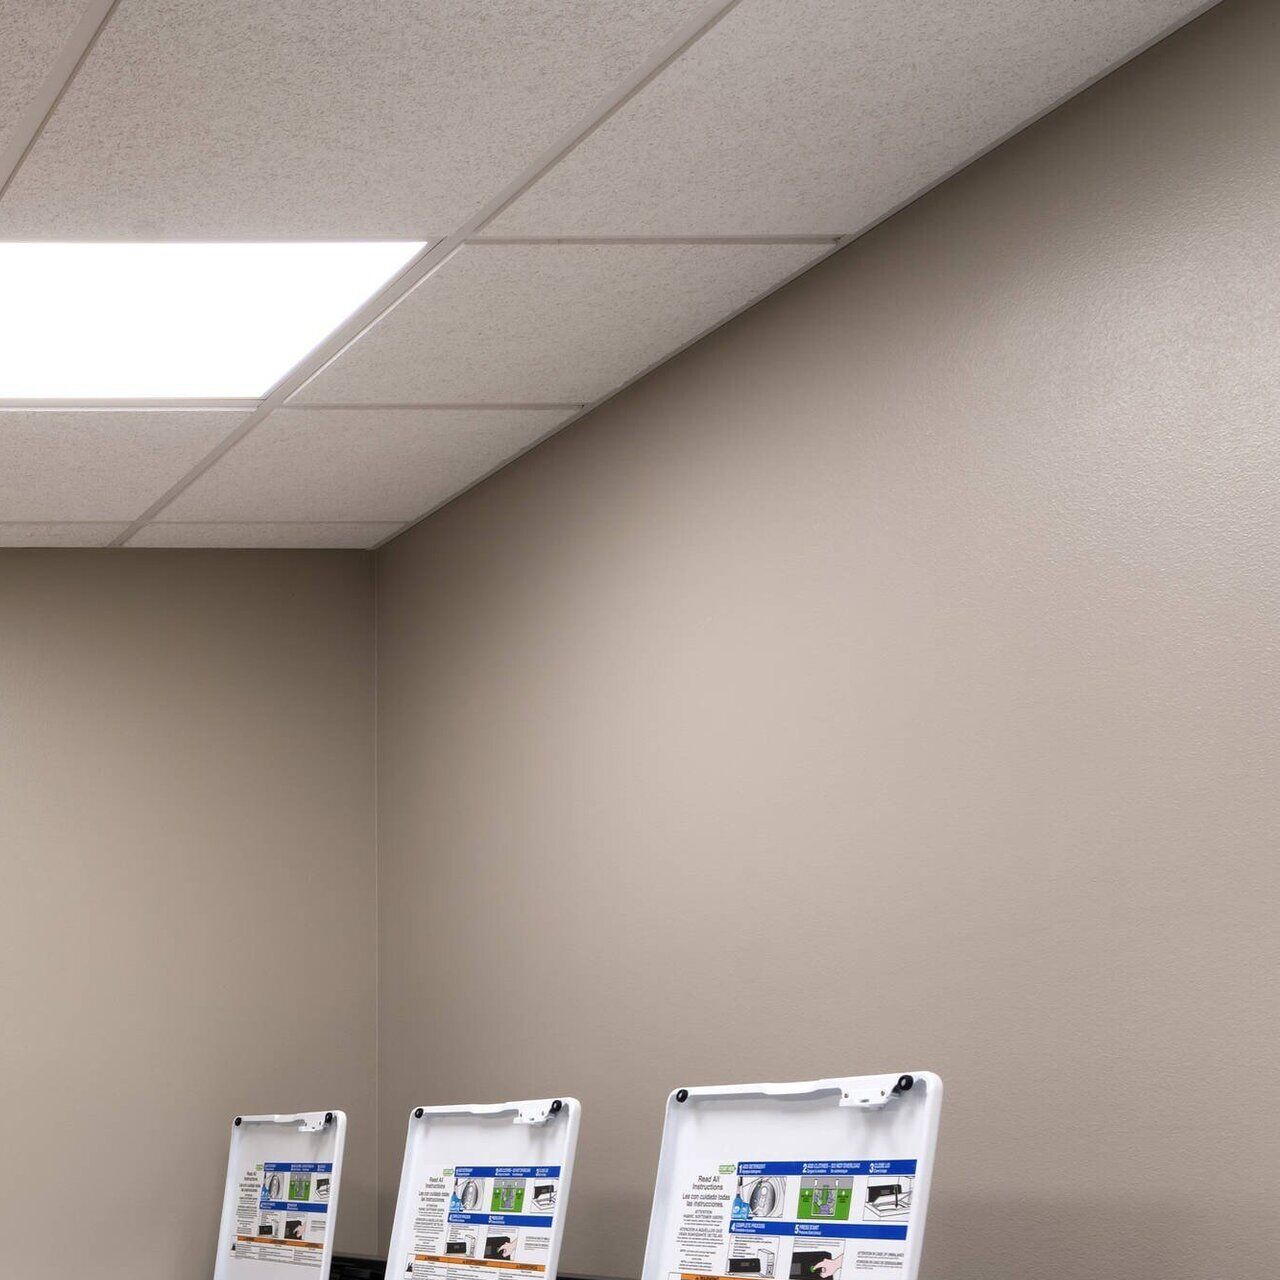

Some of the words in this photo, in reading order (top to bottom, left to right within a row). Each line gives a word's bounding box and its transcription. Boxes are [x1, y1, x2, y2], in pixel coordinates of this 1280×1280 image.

[802, 1163, 808, 1173] 2
[869, 1163, 875, 1173] 3
[731, 1222, 736, 1232] 4
[794, 1224, 800, 1234] 5
